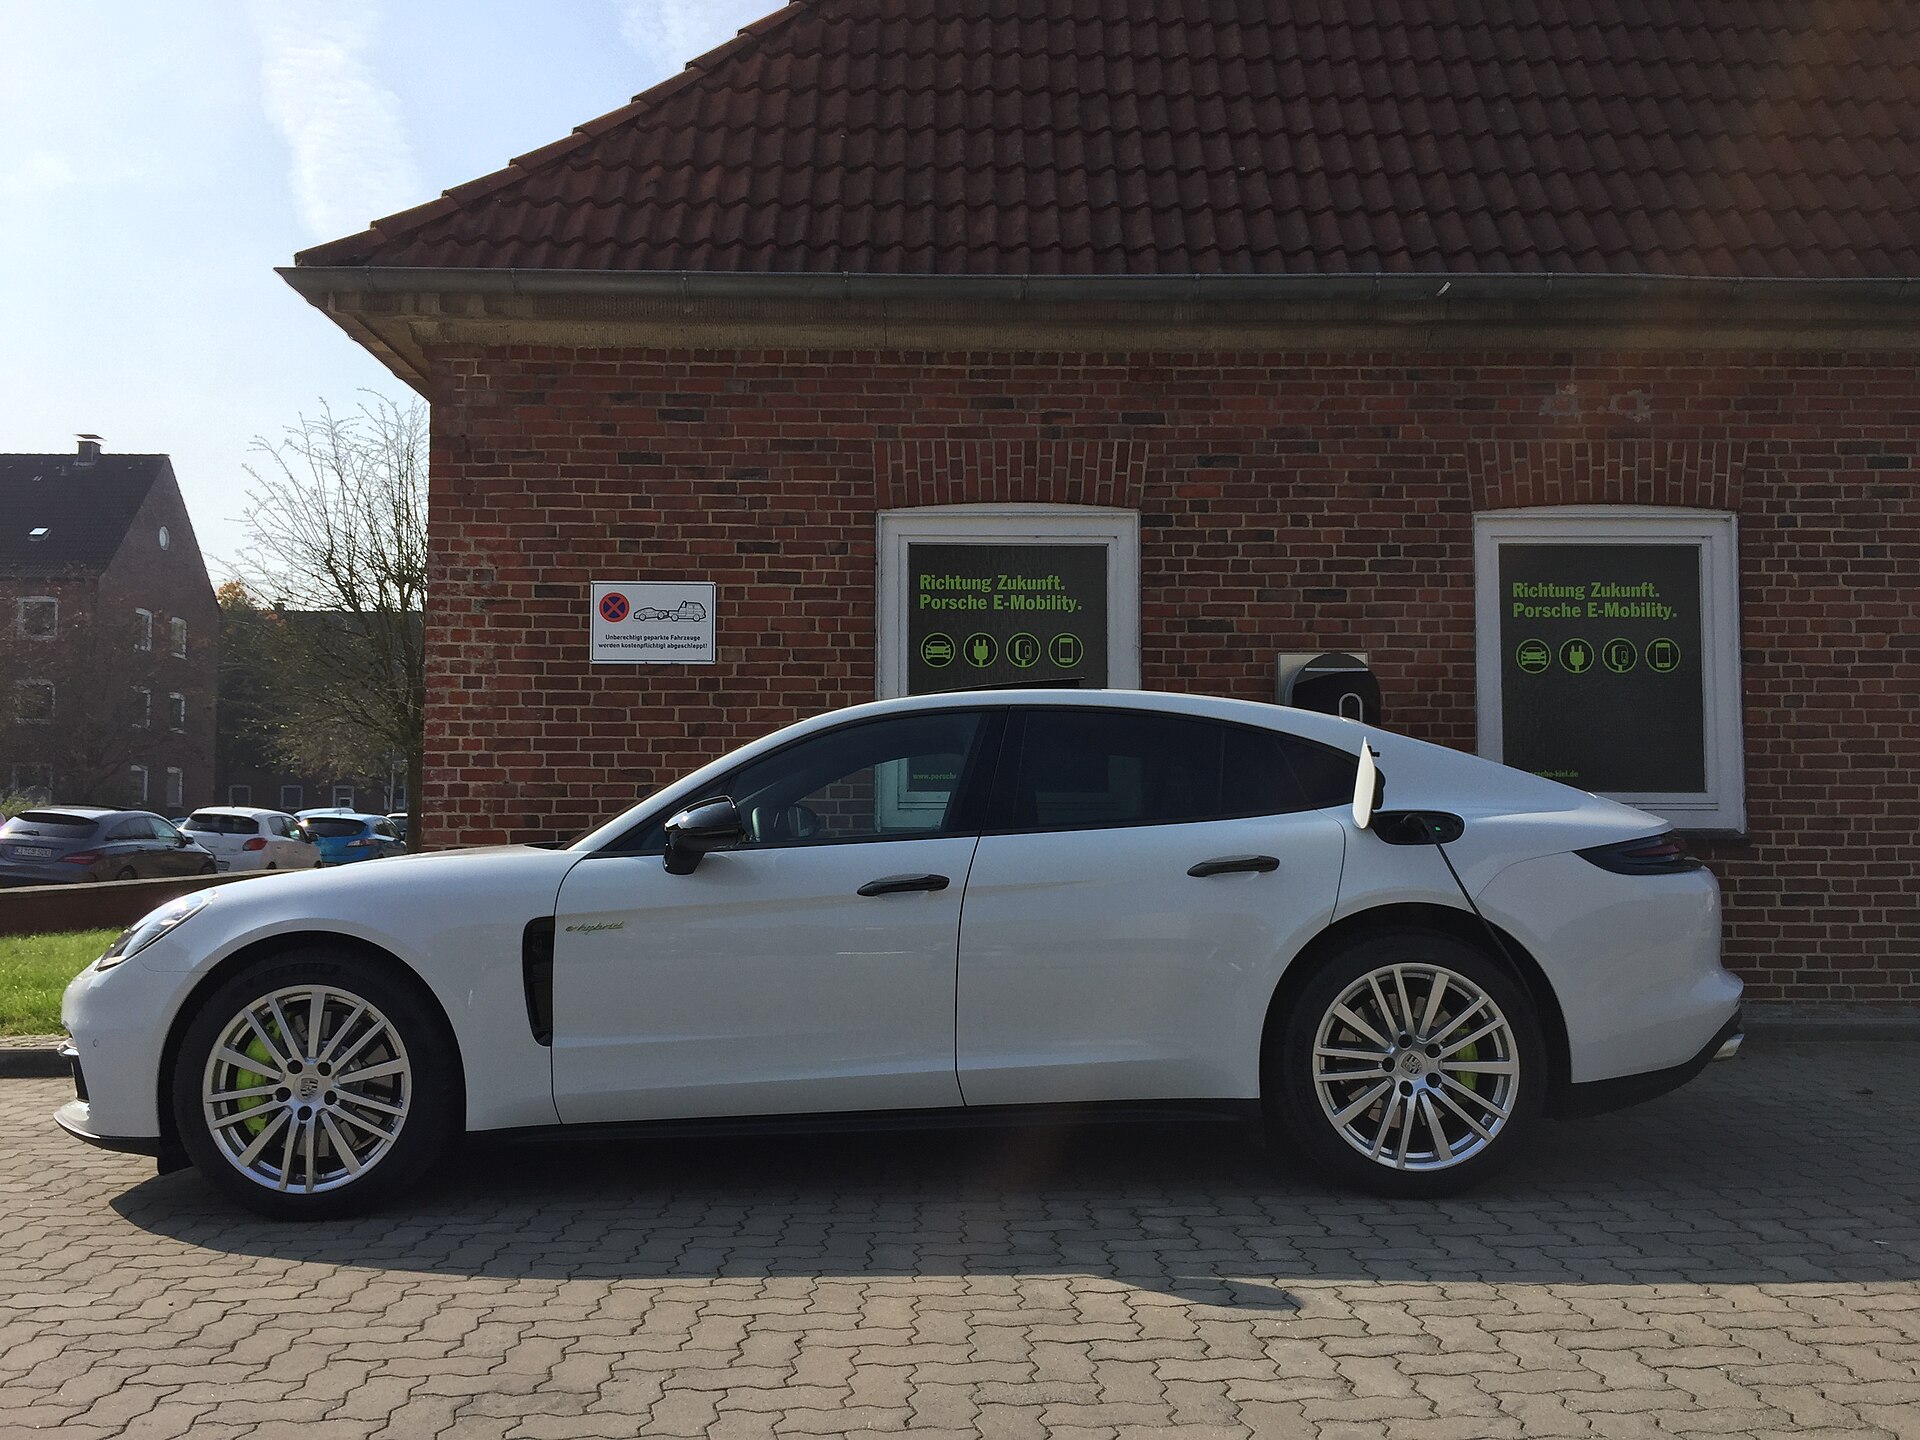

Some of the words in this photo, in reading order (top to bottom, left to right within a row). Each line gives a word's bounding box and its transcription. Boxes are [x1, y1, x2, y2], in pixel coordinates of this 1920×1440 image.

[919, 574, 992, 593] Richtung
[996, 574, 1066, 591] Zukunft.
[1512, 582, 1585, 600] Richtung
[1590, 582, 1660, 598] Zukunft.
[919, 594, 988, 610] Porsche
[993, 594, 1082, 613] E-Mobility.
[1512, 602, 1582, 618] Porsche
[1587, 602, 1678, 620] E-Mobility.
[605, 634, 643, 642] Unberechtigt
[643, 634, 670, 642] geparkte
[670, 634, 701, 642] Fahrzeuge
